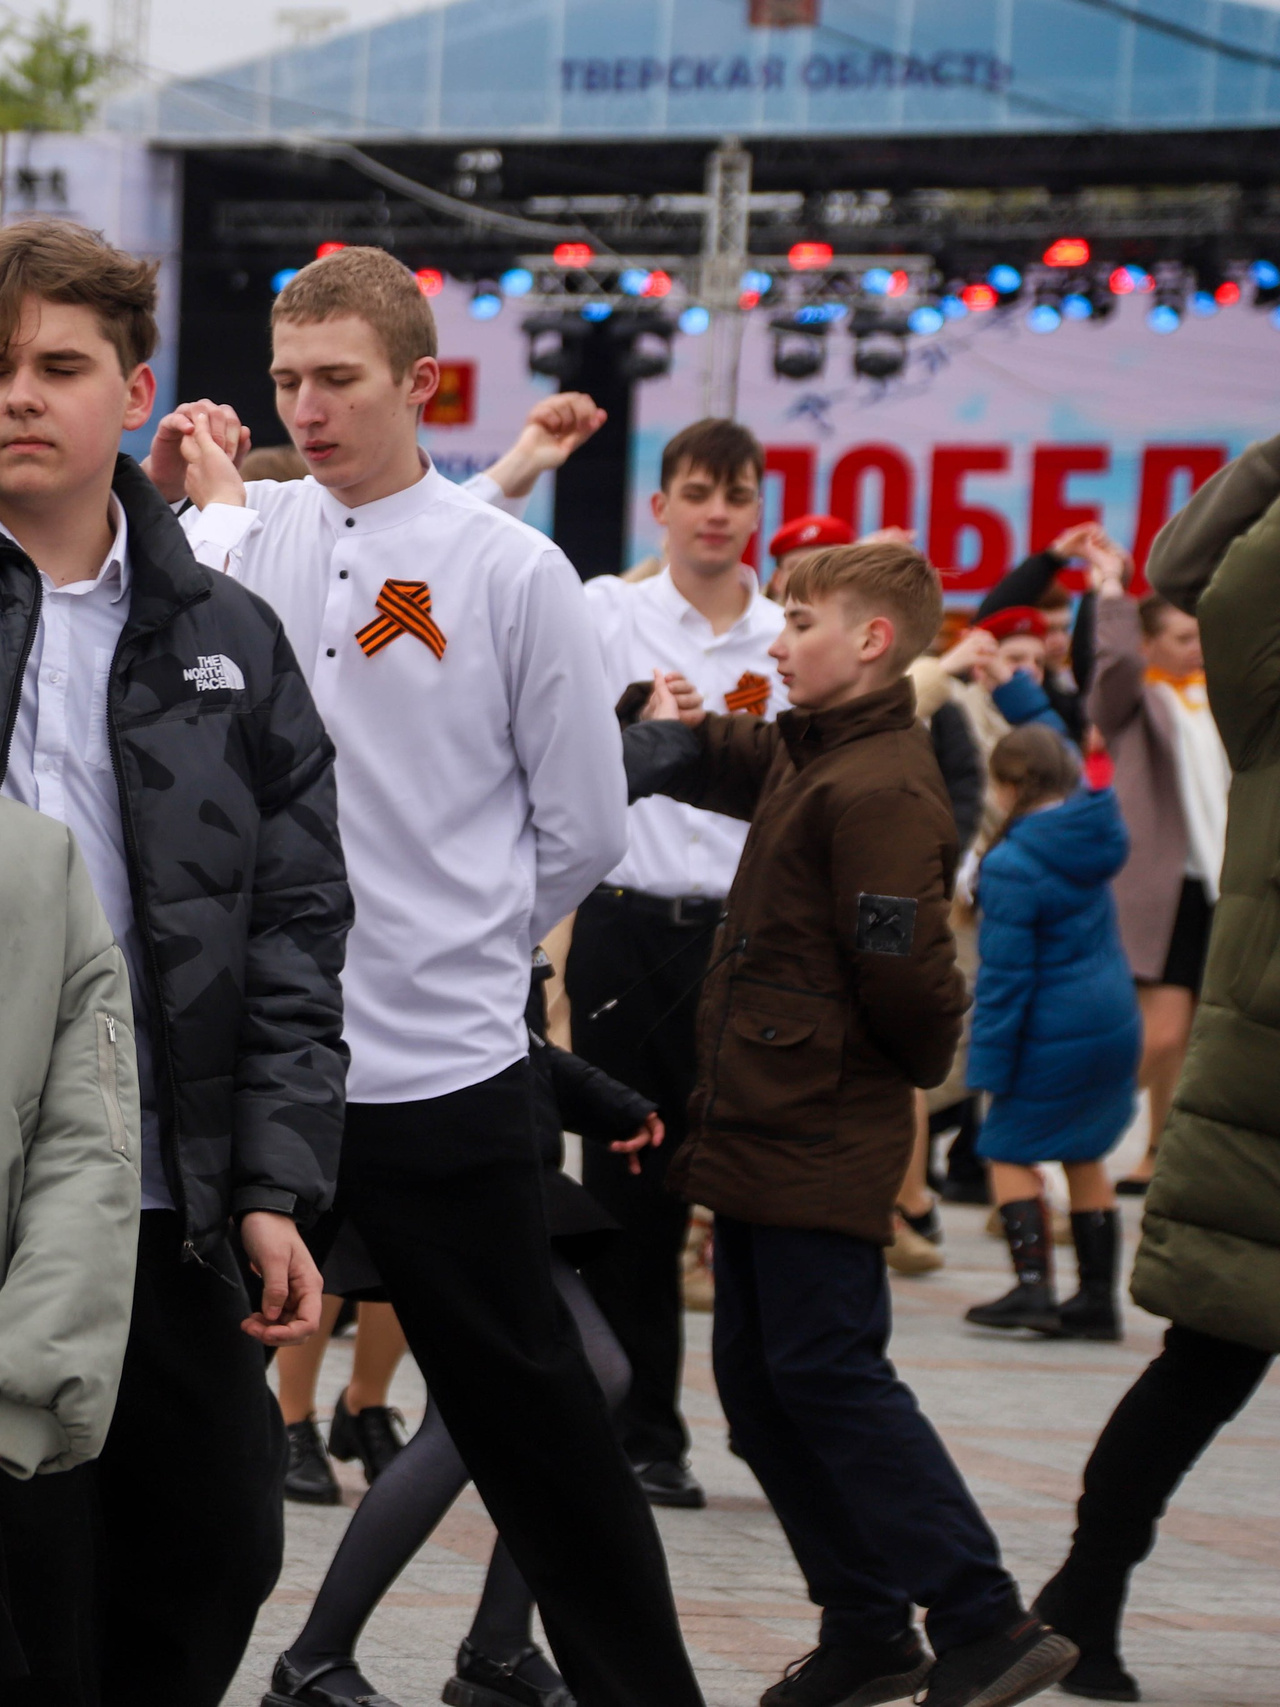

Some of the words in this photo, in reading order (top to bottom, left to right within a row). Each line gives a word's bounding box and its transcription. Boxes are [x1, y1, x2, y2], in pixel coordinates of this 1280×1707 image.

[561, 57, 788, 94] ТВЕРСКАЯ
[802, 50, 1014, 90] ОБЛАСТЬ
[197, 655, 222, 668] THE
[183, 667, 224, 681] NORTH
[196, 678, 227, 692] FACE
